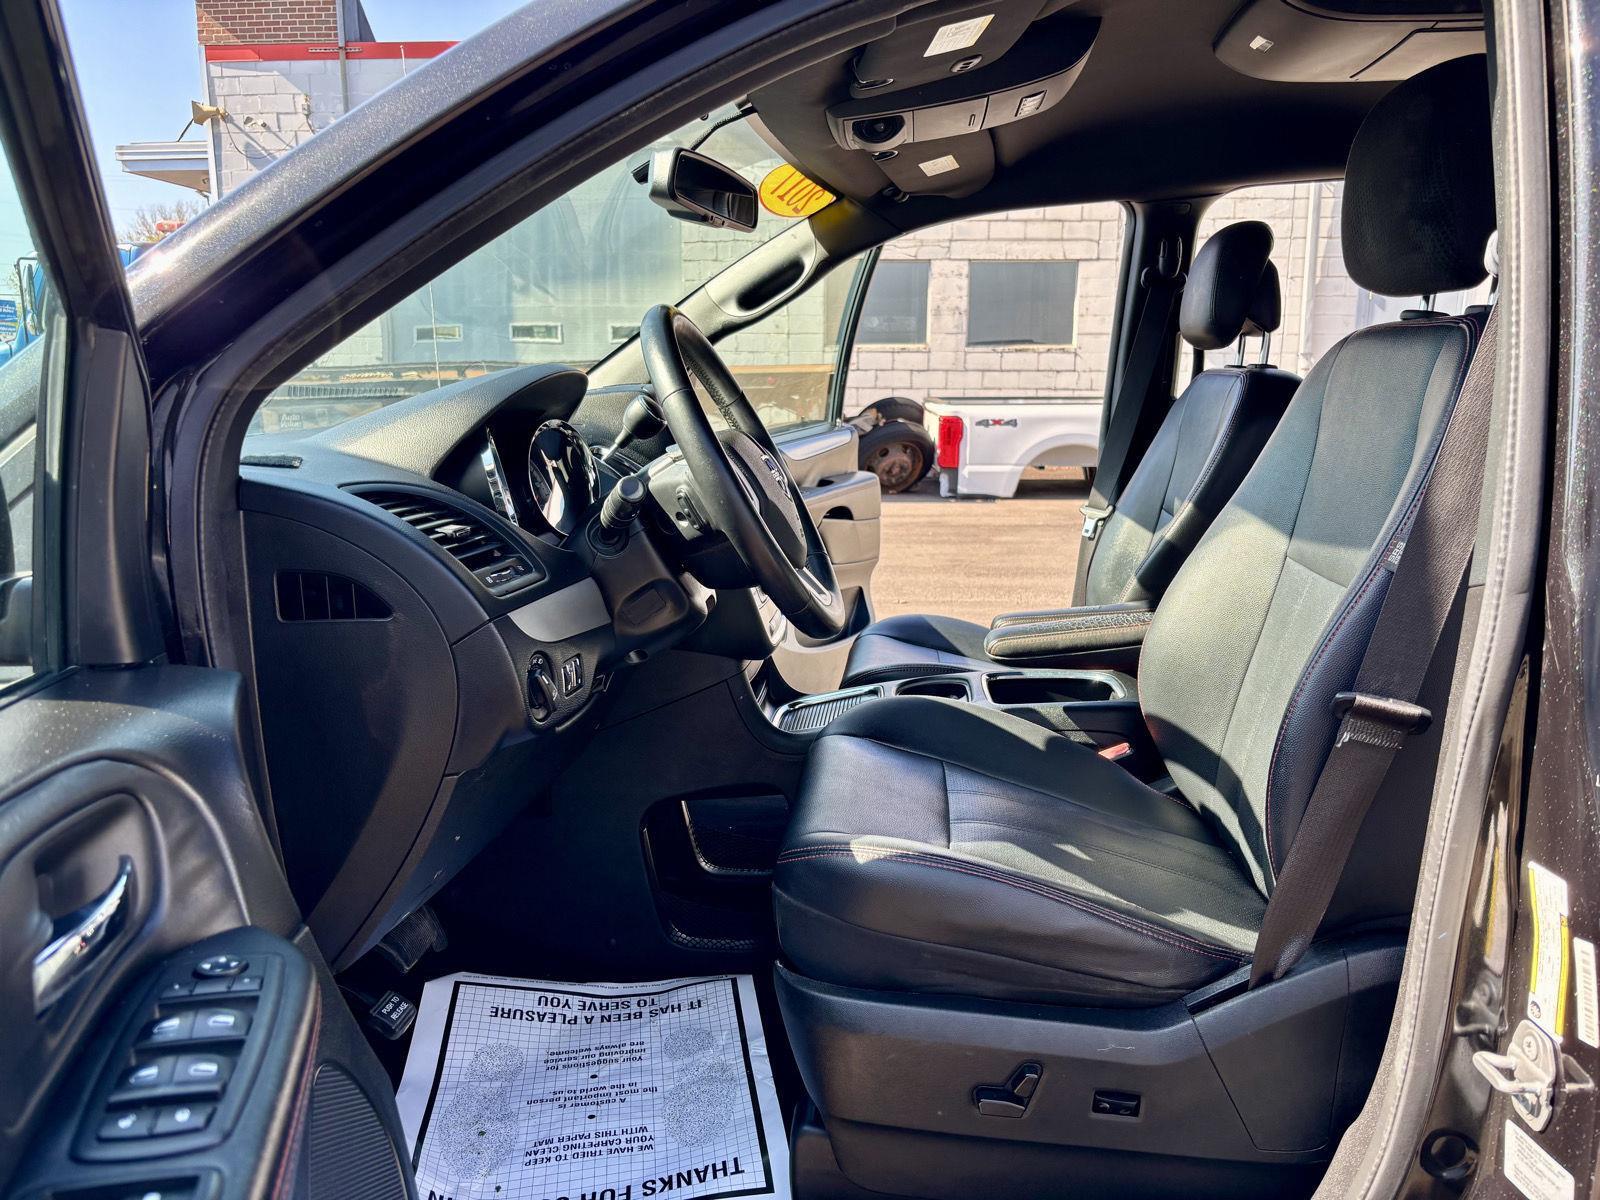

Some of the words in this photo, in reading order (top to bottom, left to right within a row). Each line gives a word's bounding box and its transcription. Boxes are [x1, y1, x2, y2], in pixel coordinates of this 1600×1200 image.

[538, 996, 571, 1010] YOU
[578, 1000, 630, 1011] SERVE
[637, 998, 658, 1007] TO
[688, 1000, 702, 1010] IT
[382, 1002, 395, 1014] PUSH
[390, 1001, 409, 1020] RELEASE
[649, 1004, 682, 1018] HAS
[489, 1006, 578, 1025] PLEASURE
[584, 1016, 594, 1024] A
[601, 1011, 642, 1023] BEEN
[546, 1047, 591, 1056] welcome.
[595, 1042, 626, 1051] always
[600, 1047, 646, 1057] improving
[544, 1056, 577, 1065] service
[562, 1057, 619, 1069] suggestions
[622, 1055, 643, 1064] Your
[580, 1085, 607, 1094] world
[615, 1088, 639, 1097] most
[527, 1097, 561, 1105] person
[563, 1092, 612, 1102] important
[569, 1098, 616, 1107] customer
[594, 1129, 618, 1139] THIS
[621, 1126, 648, 1136] WITH
[533, 1137, 554, 1148] MAT
[558, 1132, 591, 1143] PAPER
[625, 1134, 654, 1145] YOUR
[562, 1138, 622, 1151] CARPETING
[638, 1144, 653, 1152] WE
[525, 1146, 559, 1157] CLEAN
[572, 1149, 604, 1159] TRIED
[607, 1146, 634, 1155] HAVE
[524, 1156, 551, 1166] KEEP
[555, 1154, 569, 1162] TO
[642, 1157, 745, 1197] THANKS
